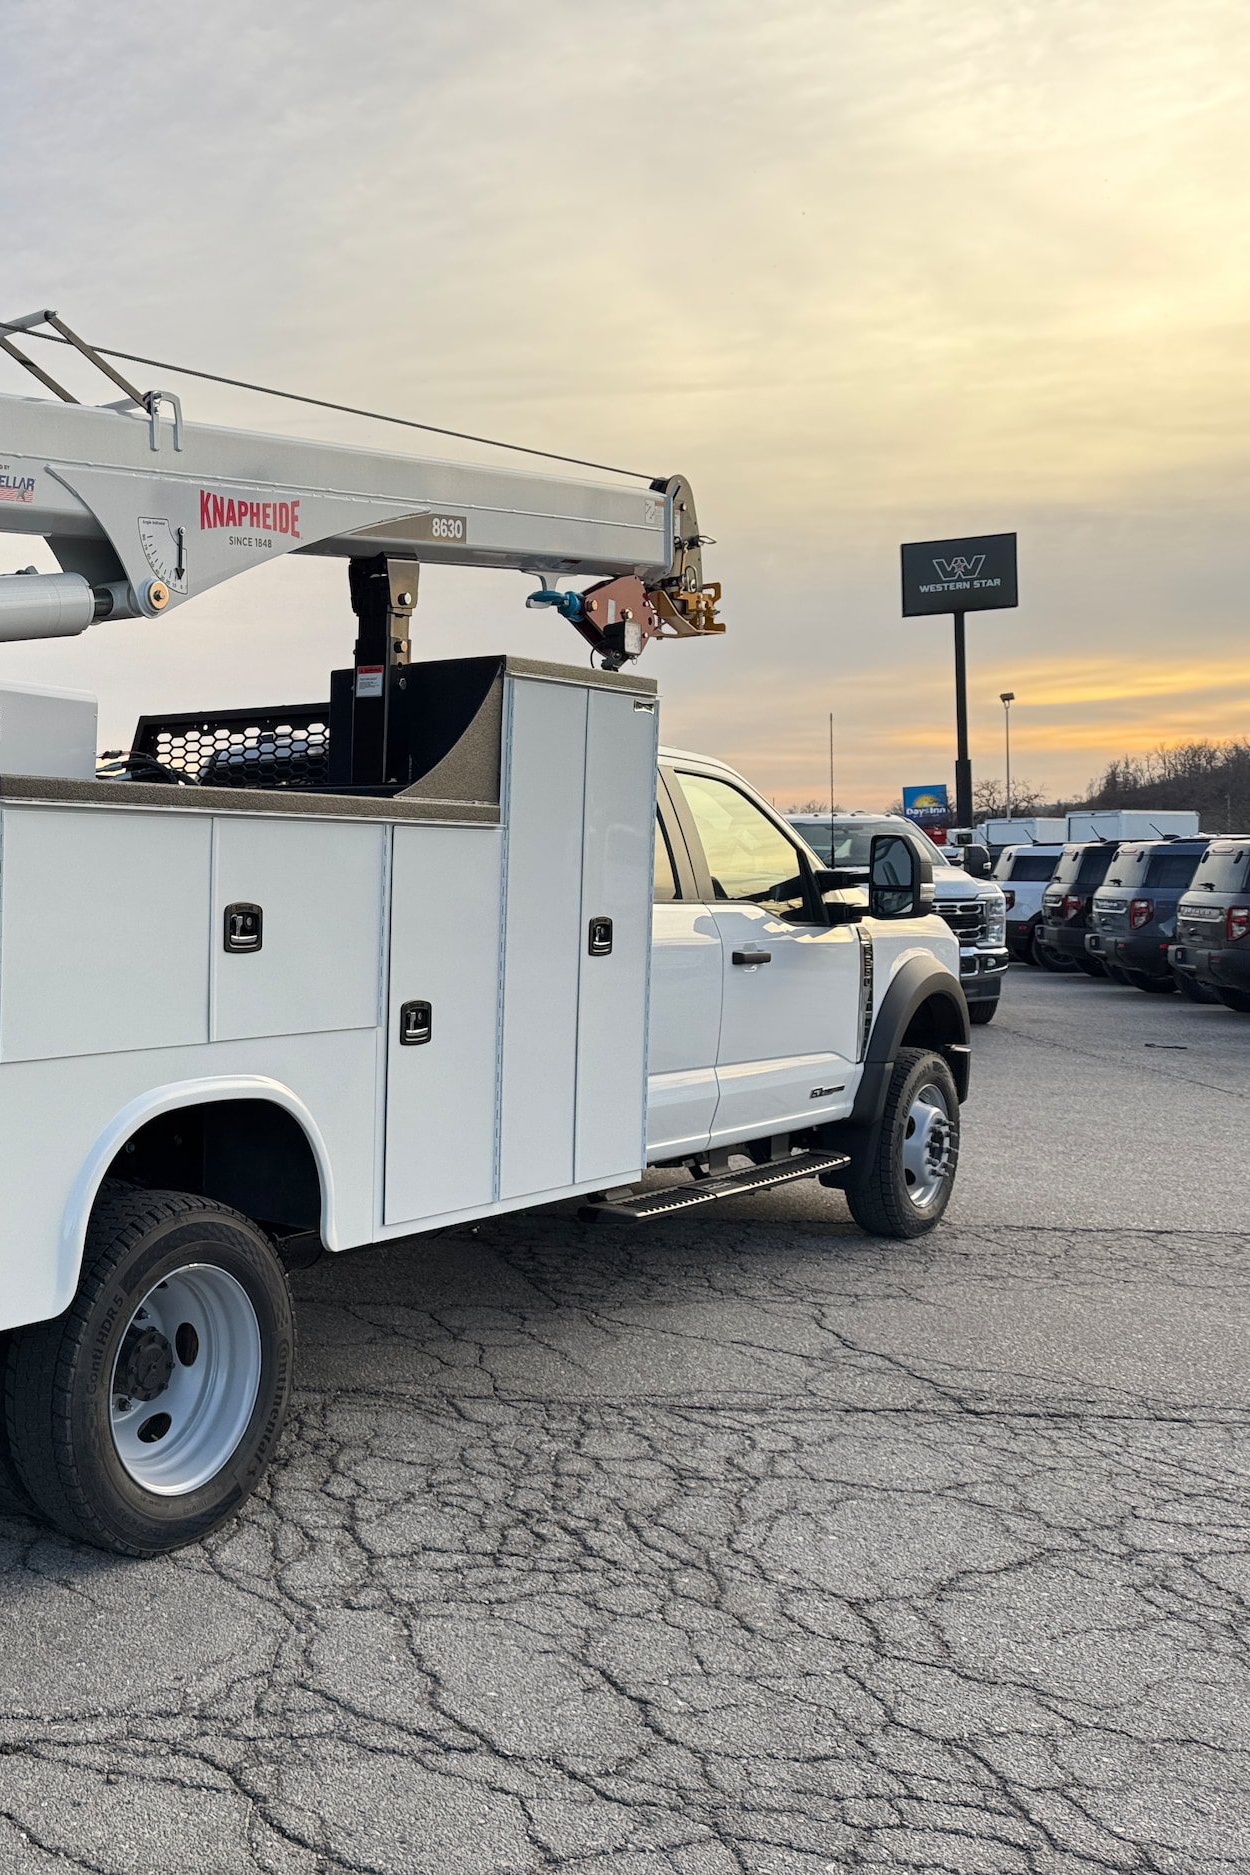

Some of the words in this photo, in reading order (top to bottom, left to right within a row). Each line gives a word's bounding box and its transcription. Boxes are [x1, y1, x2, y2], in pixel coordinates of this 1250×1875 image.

[199, 489, 301, 539] KNAPHEIDE
[432, 517, 463, 539] 8630
[229, 536, 253, 547] SINCE
[254, 538, 272, 548] 1848
[919, 581, 970, 593] WESTERN
[973, 578, 1001, 588] STAR
[97, 1306, 118, 1346] HDR
[113, 1295, 124, 1305] 5
[253, 1338, 290, 1465] Continental
